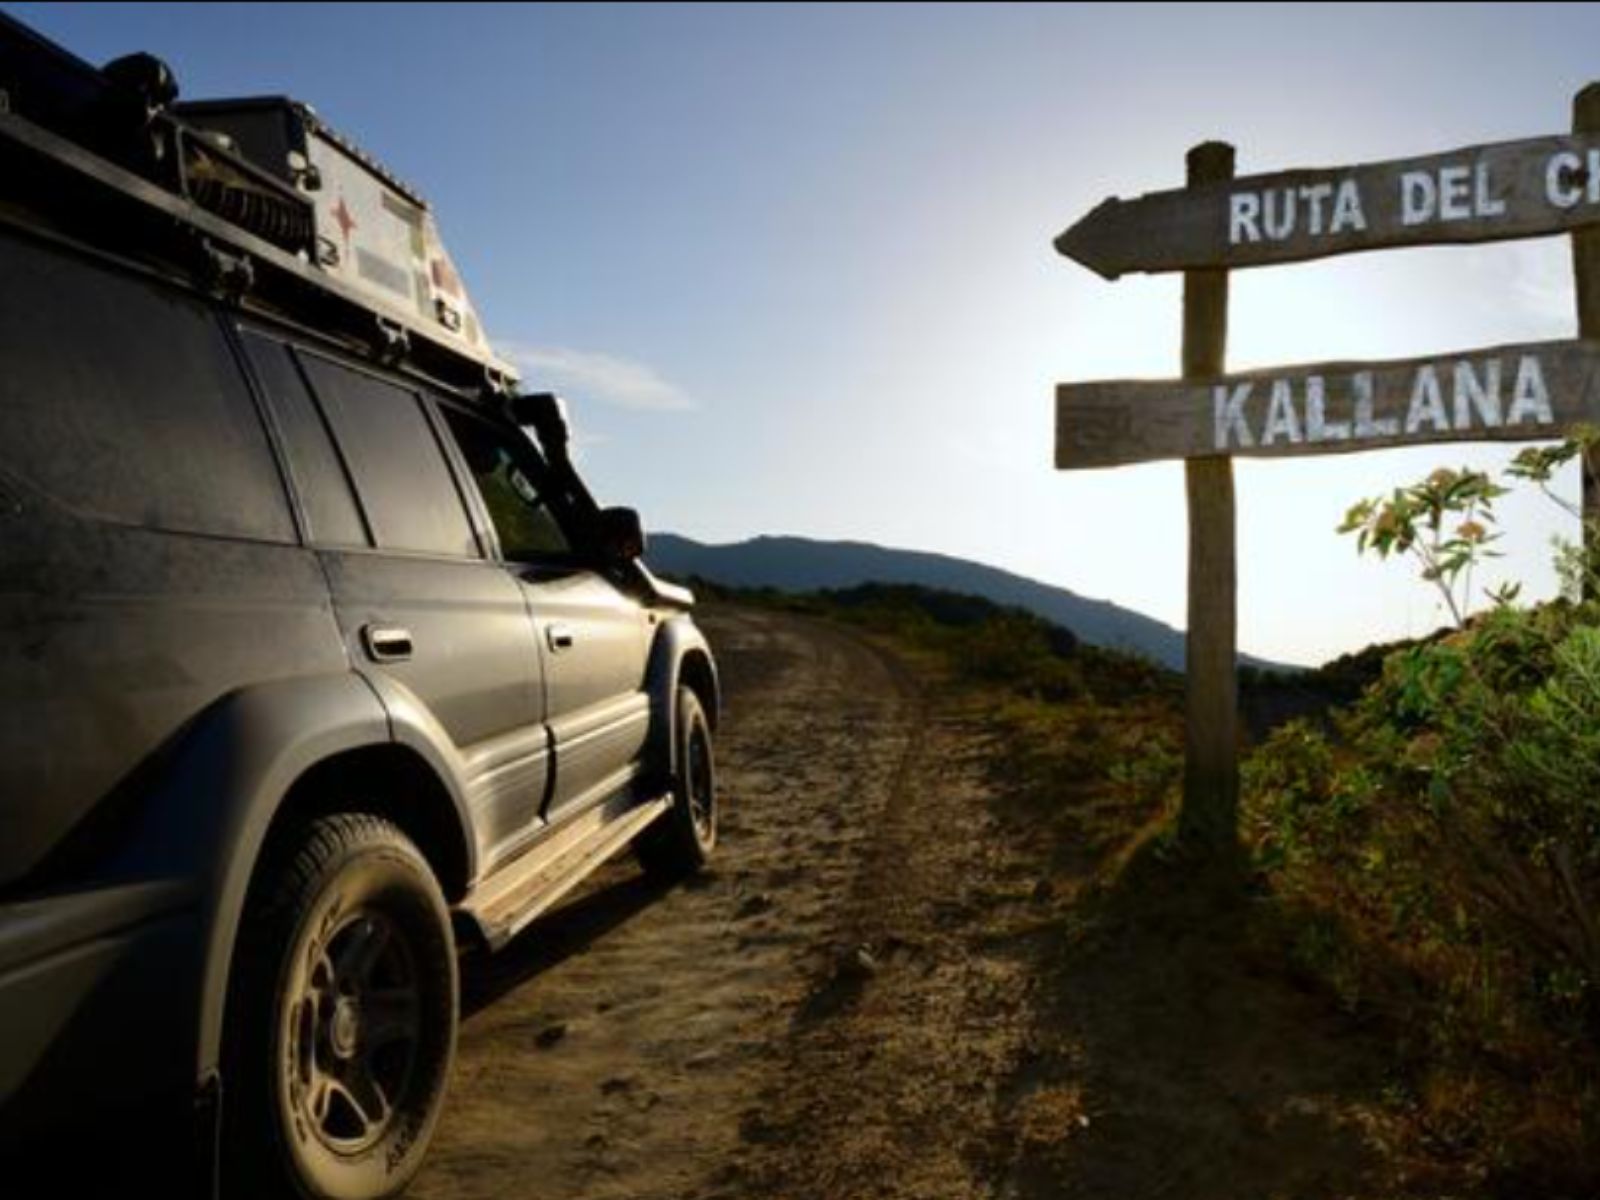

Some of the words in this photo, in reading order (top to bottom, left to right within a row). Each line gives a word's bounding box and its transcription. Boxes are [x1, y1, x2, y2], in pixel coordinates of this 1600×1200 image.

[1229, 179, 1367, 243] RUTA
[1401, 162, 1506, 226] DEL
[1214, 355, 1554, 449] KALLANA
